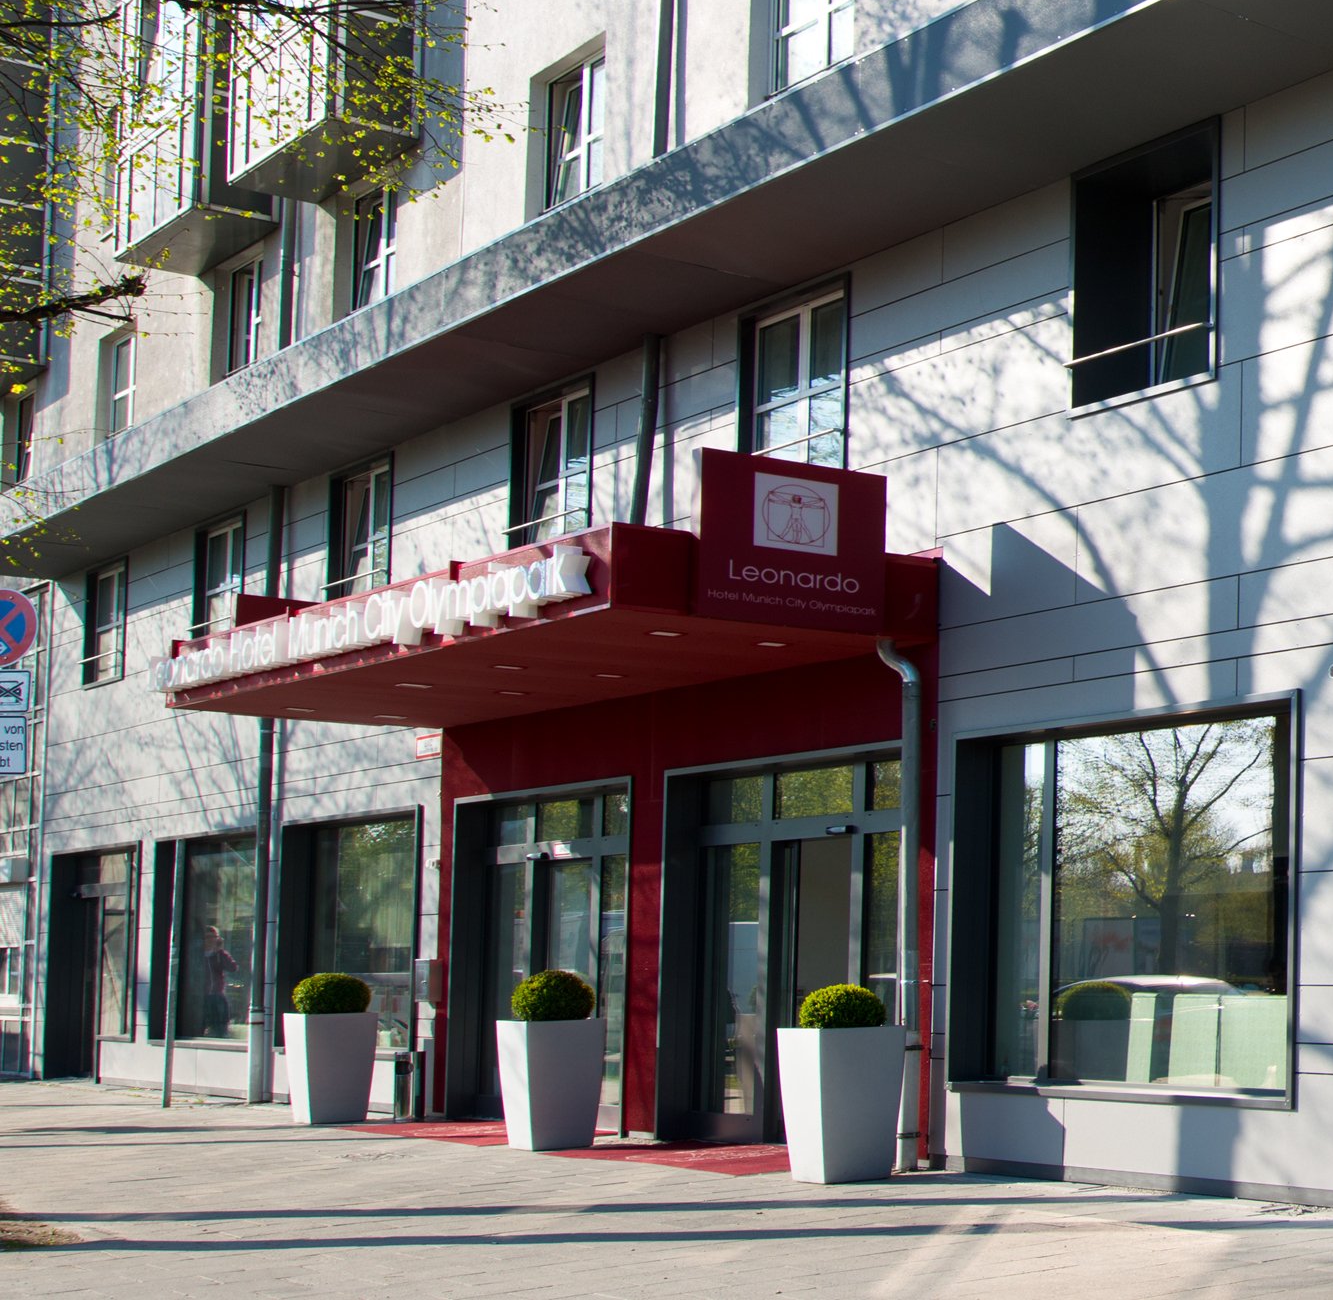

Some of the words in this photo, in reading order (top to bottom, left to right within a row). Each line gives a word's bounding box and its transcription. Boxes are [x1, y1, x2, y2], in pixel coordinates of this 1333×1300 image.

[729, 559, 860, 594] Leonardo
[230, 621, 279, 673] Hotel
[288, 601, 360, 659] Munich
[364, 589, 406, 644] City
[410, 544, 567, 636] Olympiapark
[707, 588, 739, 601] Hotel
[742, 591, 784, 605] Munich
[786, 597, 807, 610] City
[809, 600, 877, 616] Olympiapark
[4, 725, 25, 735] von
